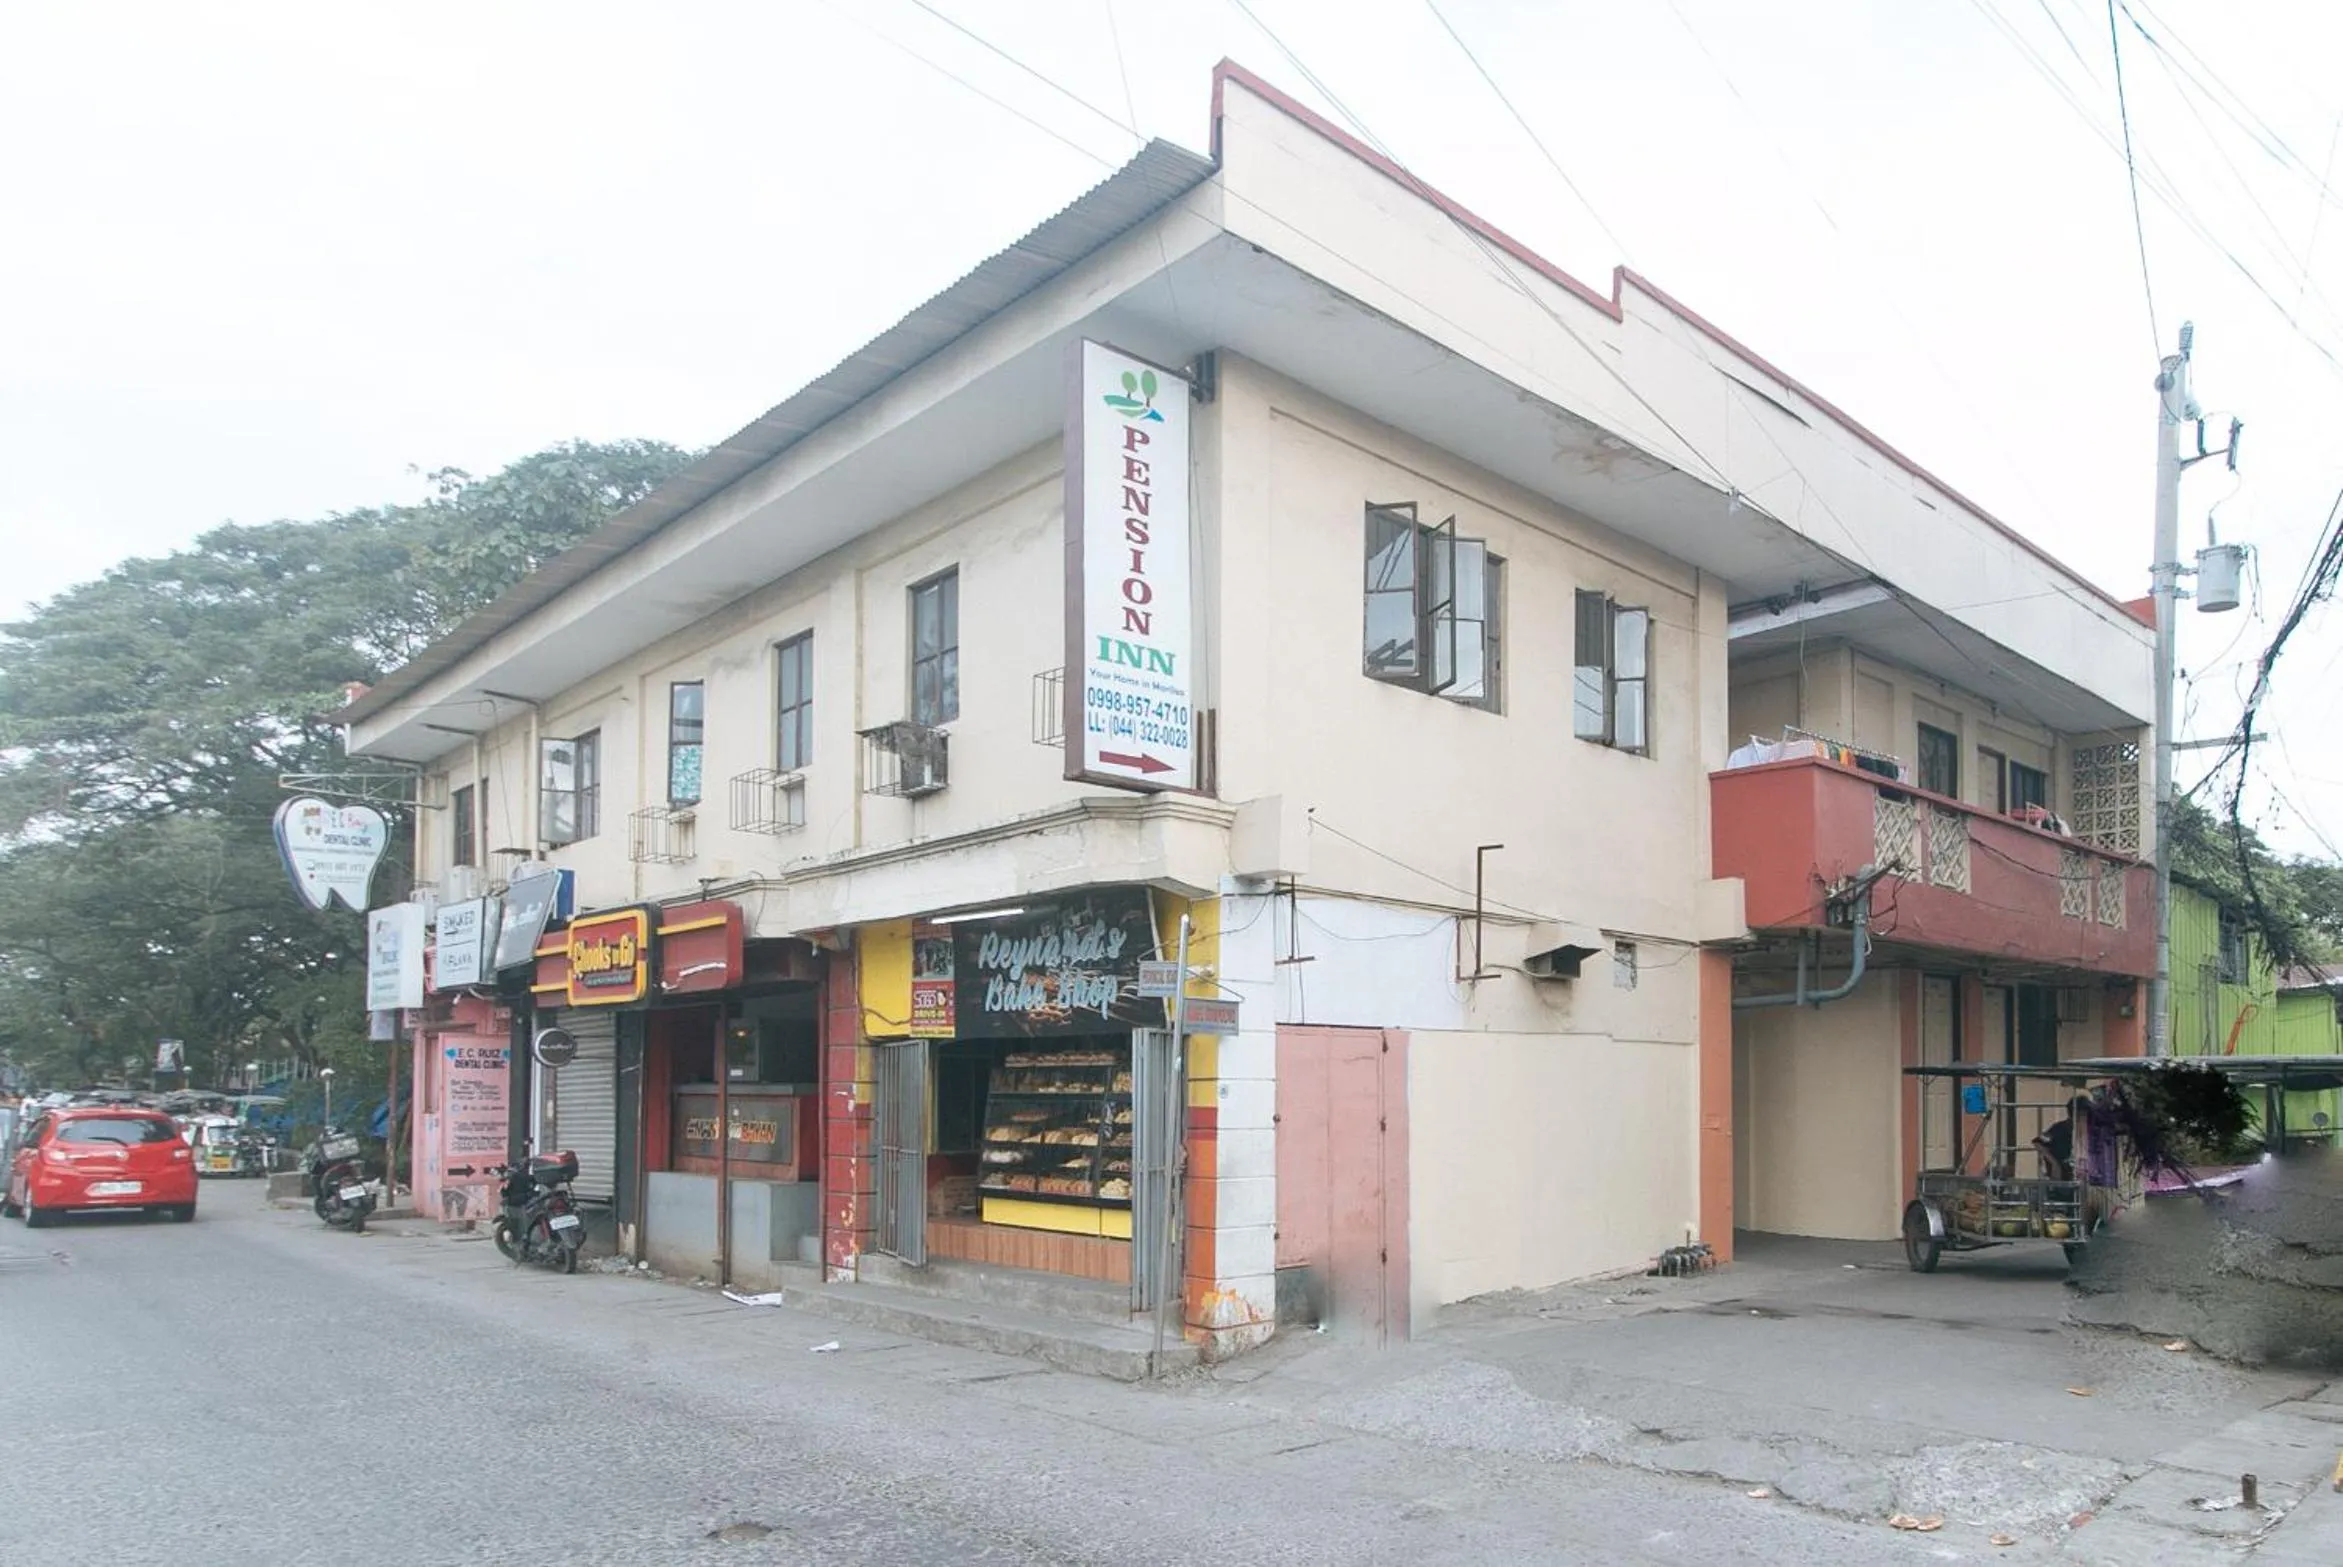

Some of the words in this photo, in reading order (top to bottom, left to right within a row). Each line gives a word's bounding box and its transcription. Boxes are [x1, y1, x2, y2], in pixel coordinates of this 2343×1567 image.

[1122, 425, 1153, 636] PENSION
[1096, 634, 1177, 677] INN
[1087, 686, 1189, 727] 0998-957-4710
[1108, 713, 1137, 744] (044)
[1139, 720, 1188, 749] 322-0028
[620, 934, 636, 968] Go
[1056, 969, 1118, 1020] Shop
